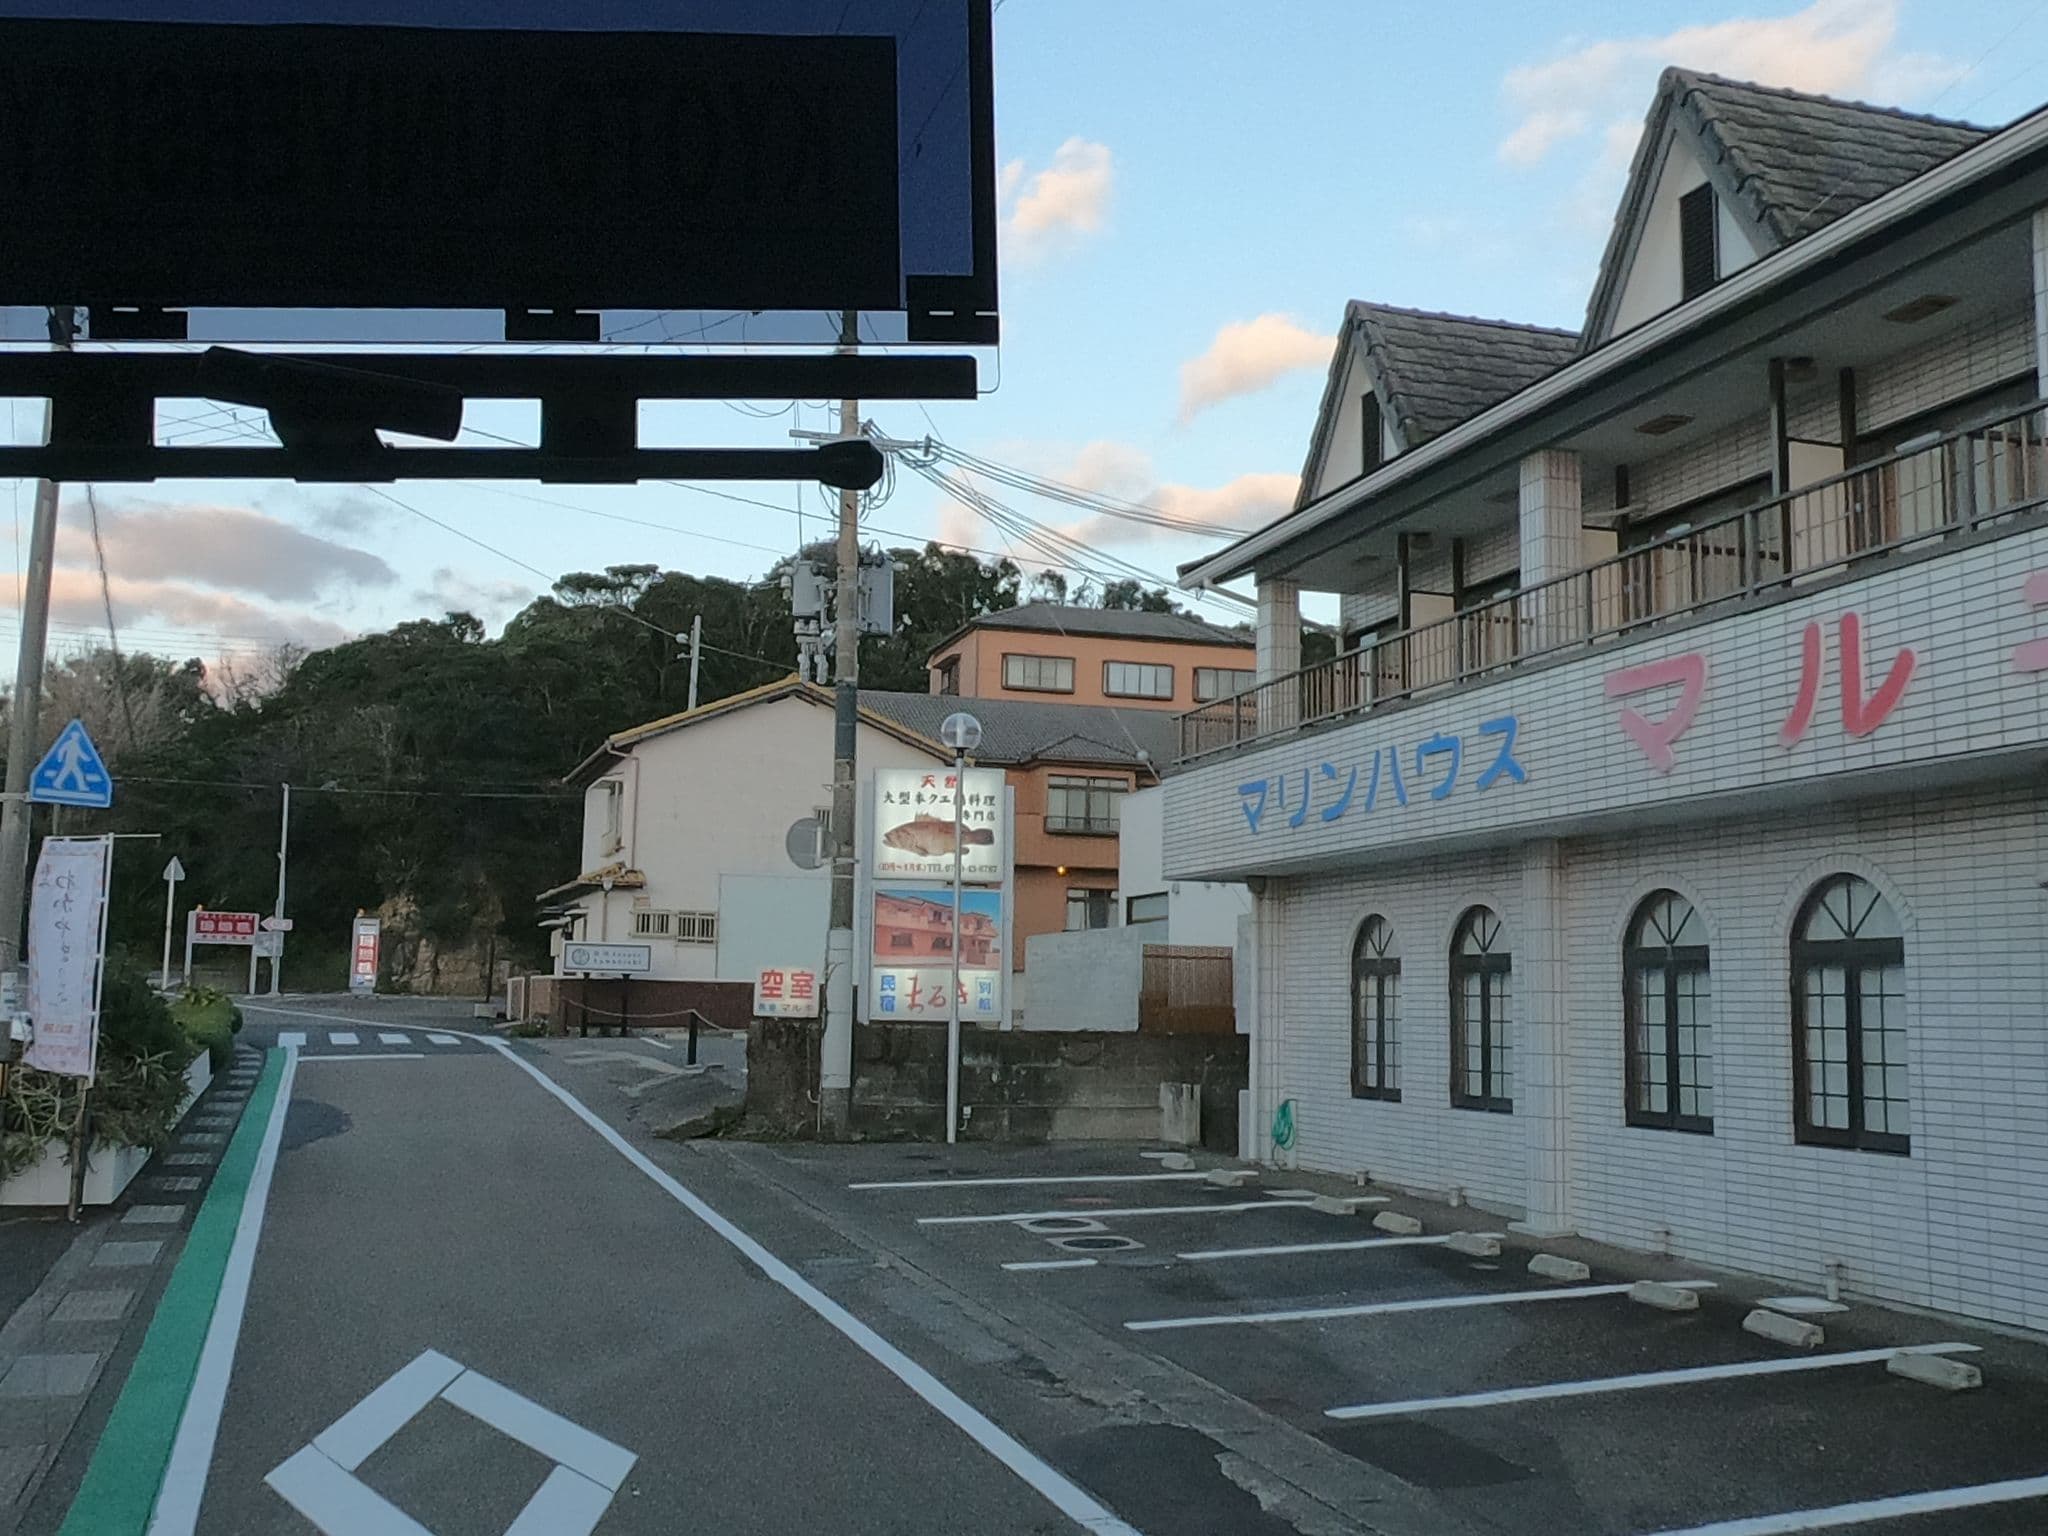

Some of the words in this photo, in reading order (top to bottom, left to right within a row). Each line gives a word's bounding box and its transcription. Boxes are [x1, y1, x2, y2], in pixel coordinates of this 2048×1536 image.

[1237, 715, 1528, 834] マリンハウス
[760, 969, 815, 999] 空室
[880, 974, 896, 1013] 民宿
